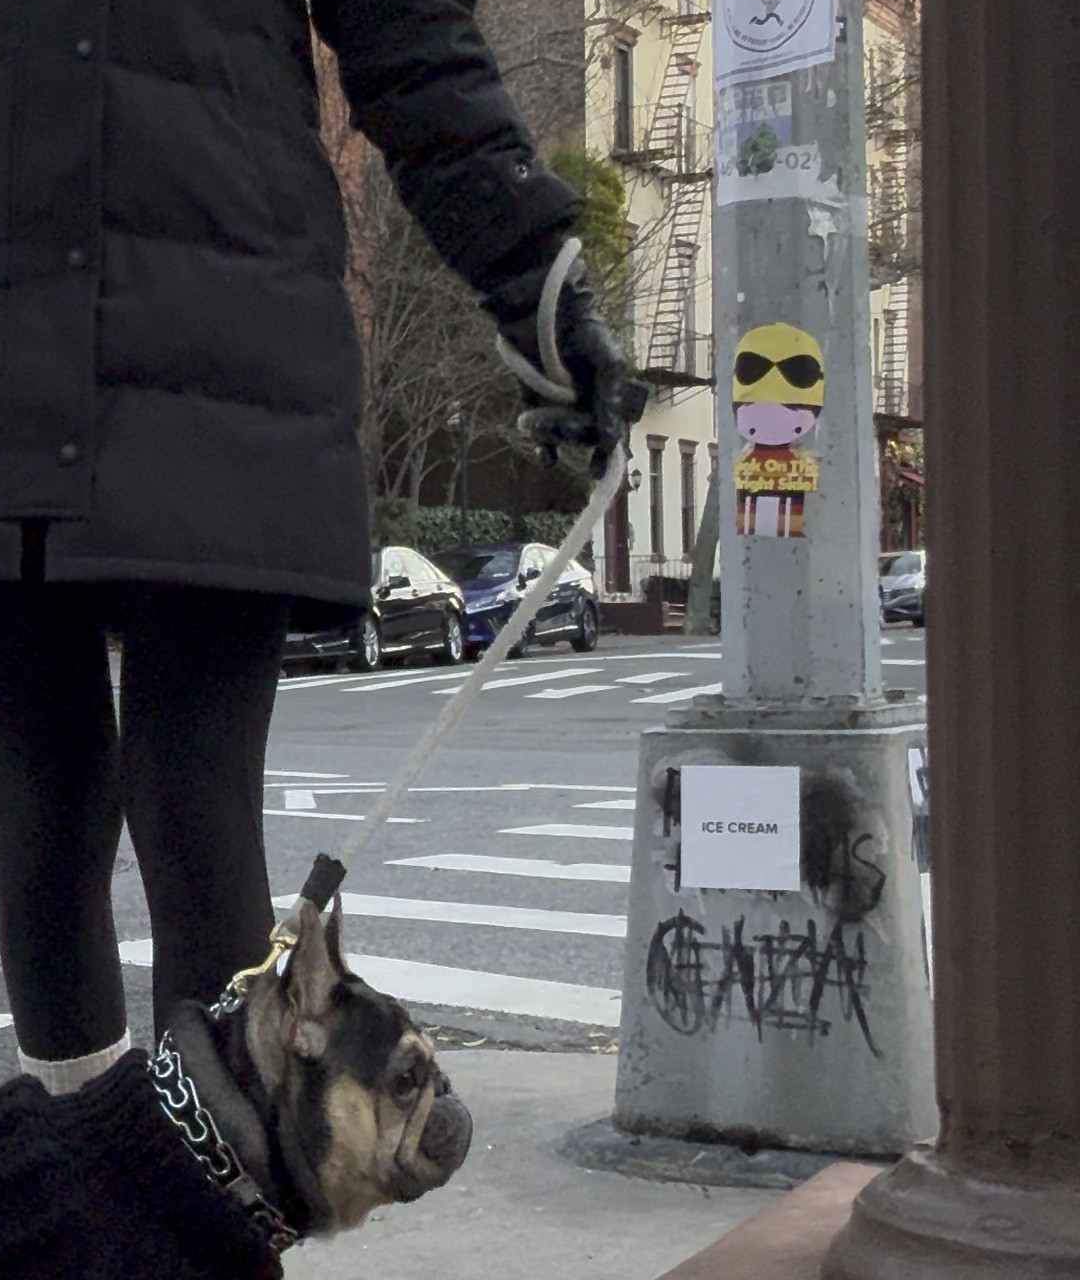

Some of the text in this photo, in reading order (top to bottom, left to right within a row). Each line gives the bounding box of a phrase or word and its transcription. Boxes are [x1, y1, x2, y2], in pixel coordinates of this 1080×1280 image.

[765, 459, 787, 472] On
[702, 821, 778, 834] ICE CREAM
